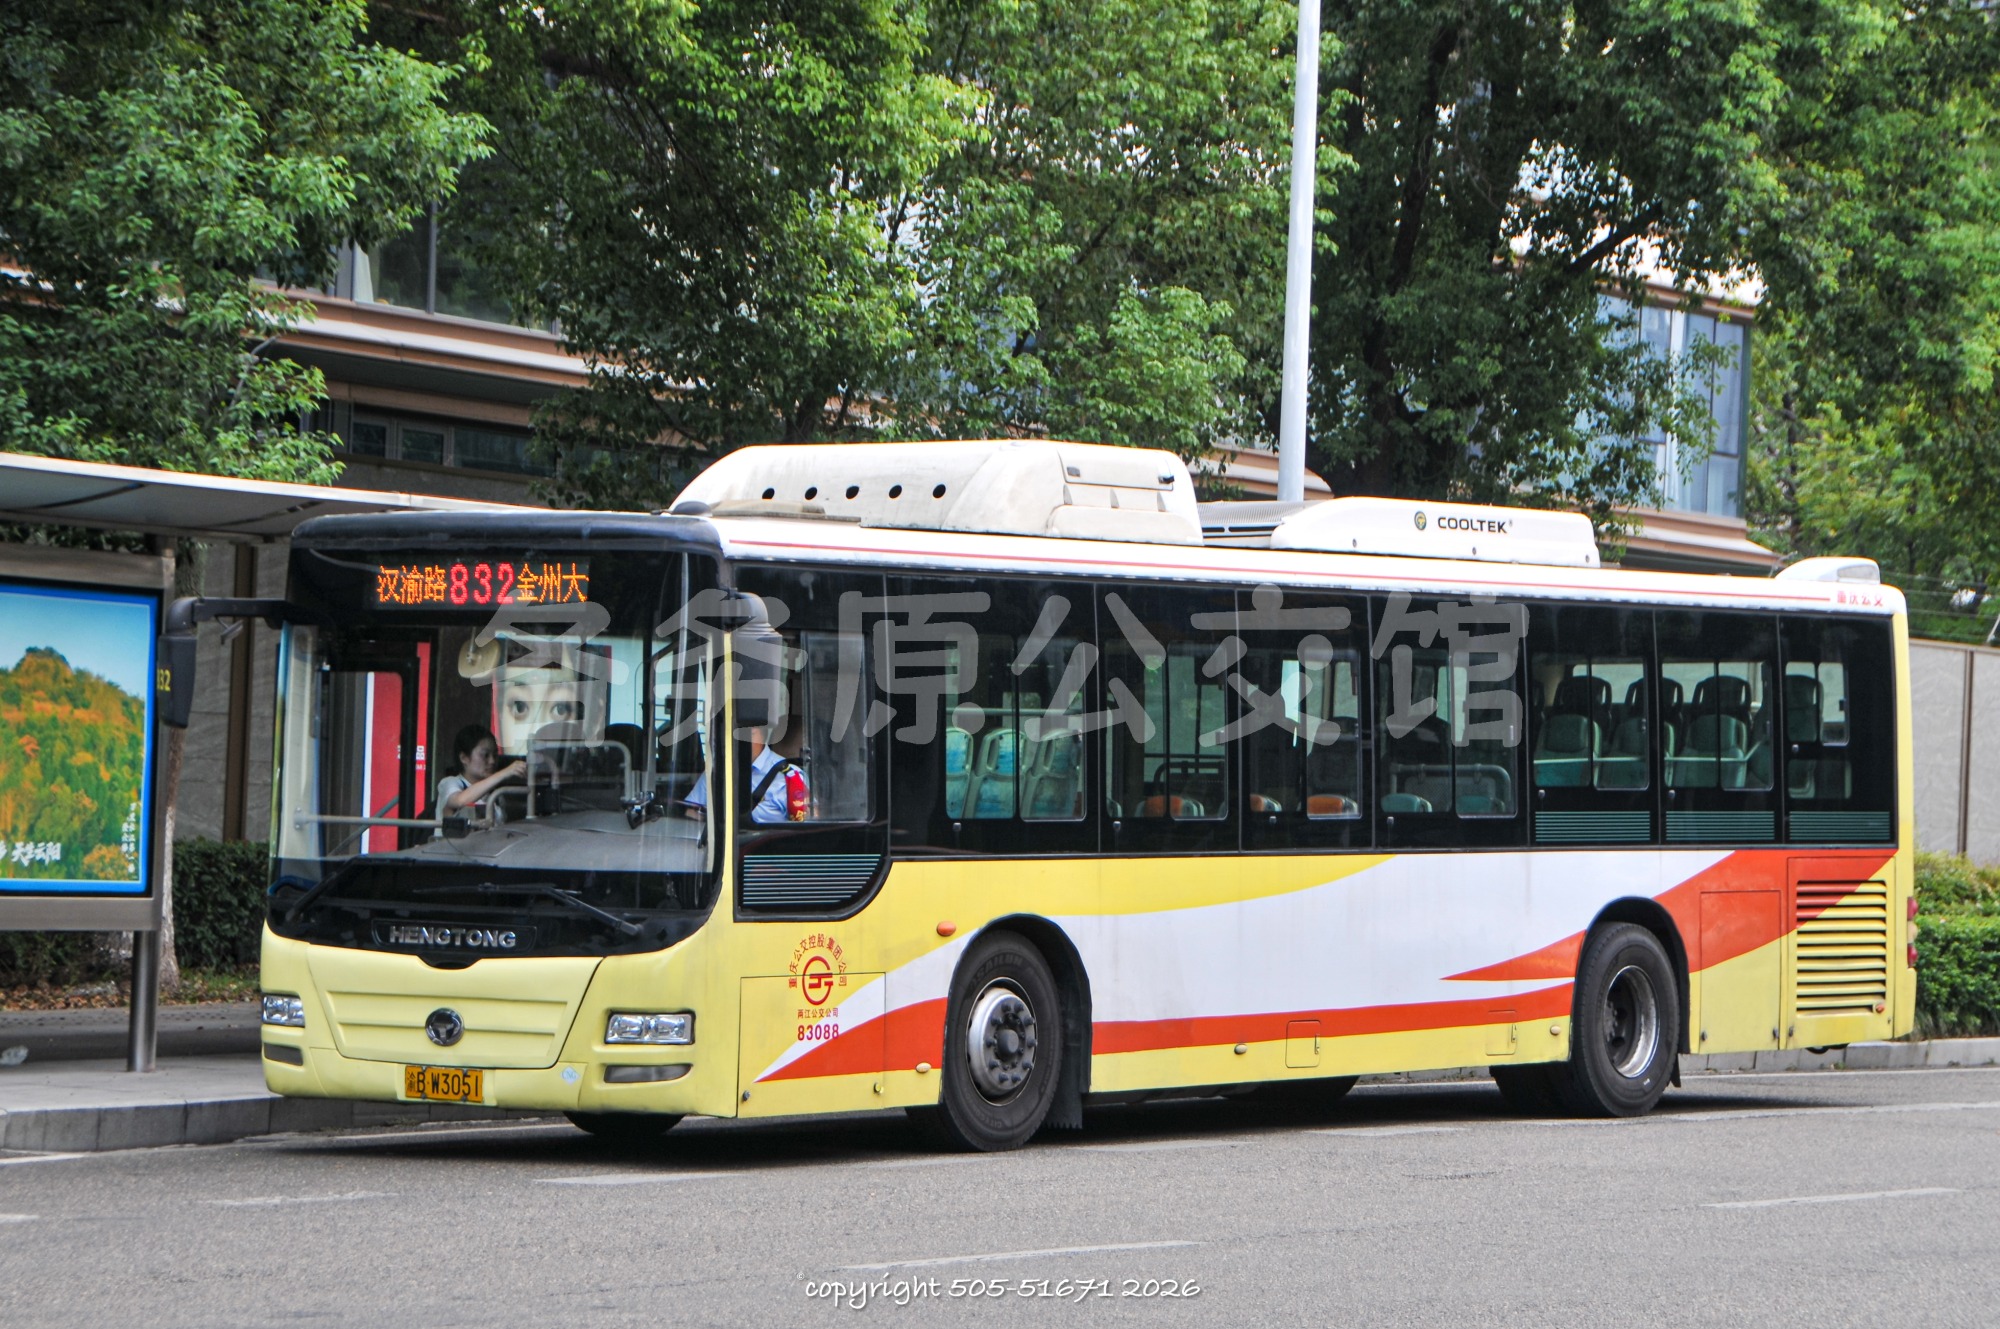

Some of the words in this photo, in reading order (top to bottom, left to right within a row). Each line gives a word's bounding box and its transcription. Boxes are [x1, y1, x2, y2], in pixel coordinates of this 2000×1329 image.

[1437, 516, 1508, 534] COOLTEK
[377, 564, 447, 605] 汉渝路
[450, 562, 516, 606] 832
[517, 562, 590, 604] 金州大
[389, 925, 516, 949] HENGTONG
[797, 1007, 839, 1019] 两江公交公司
[797, 1023, 840, 1041] 83088
